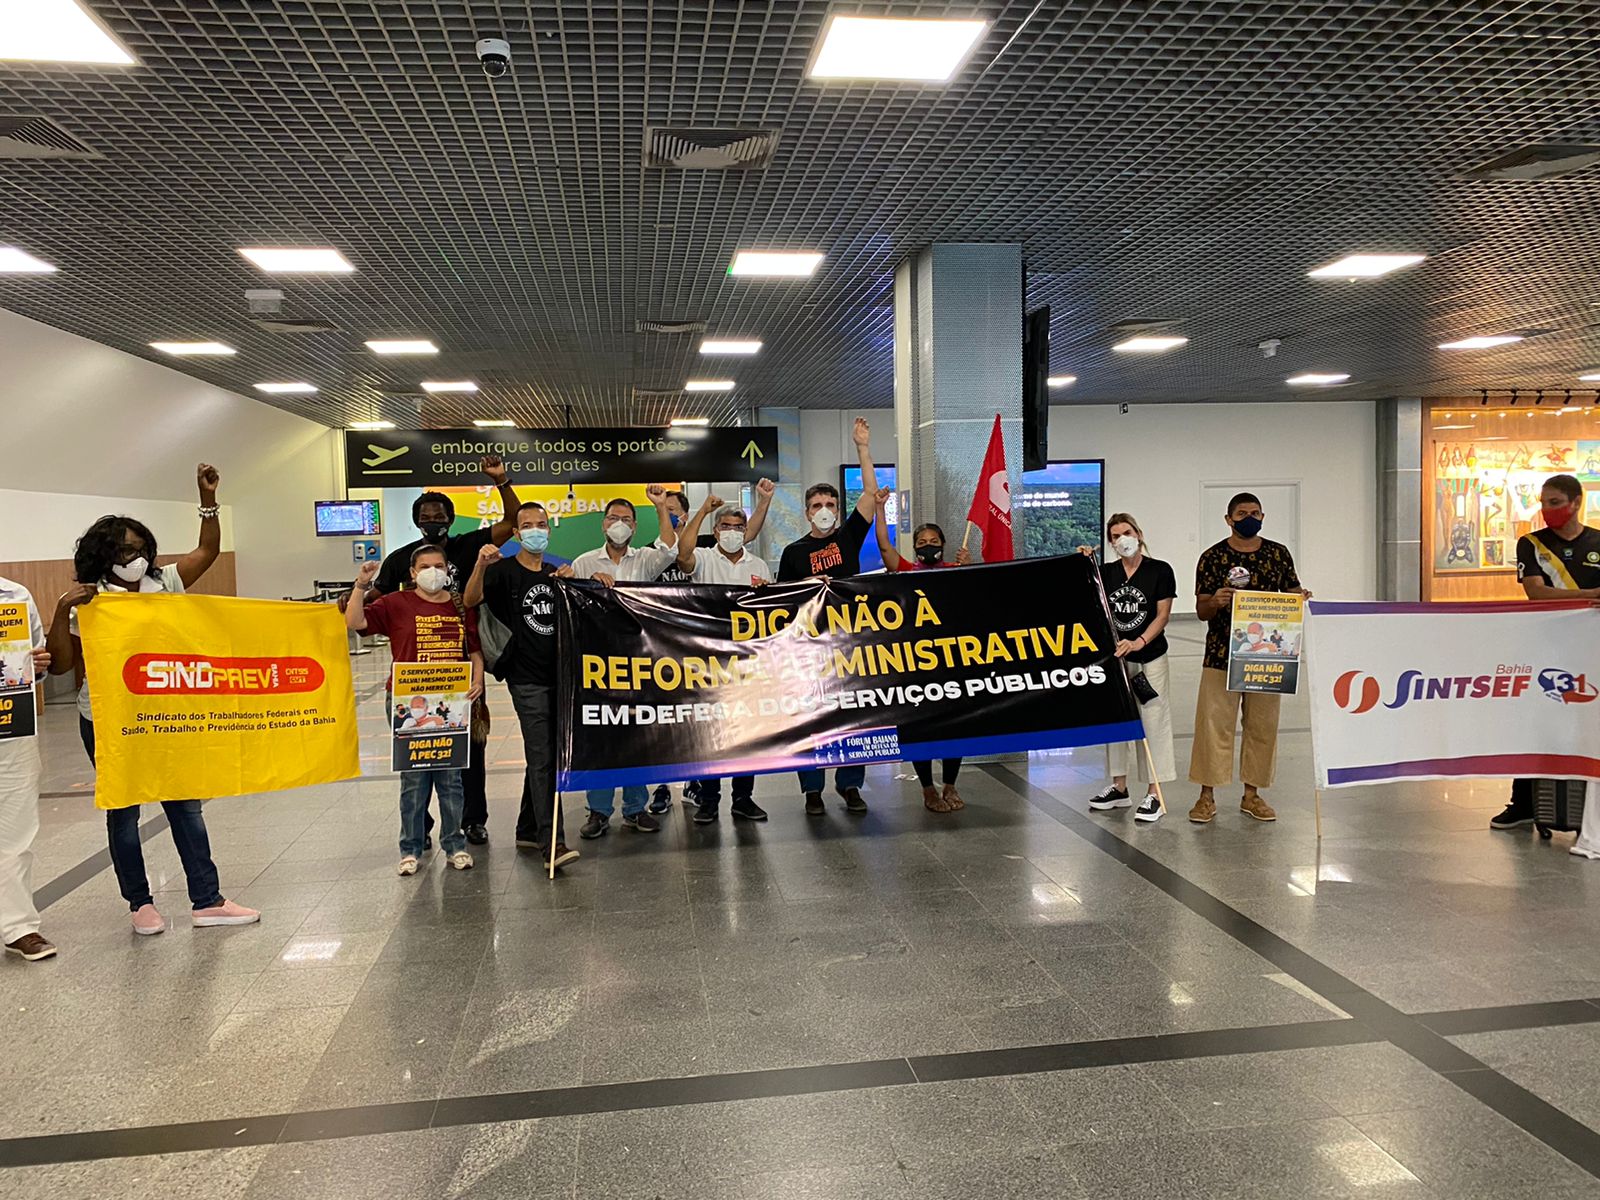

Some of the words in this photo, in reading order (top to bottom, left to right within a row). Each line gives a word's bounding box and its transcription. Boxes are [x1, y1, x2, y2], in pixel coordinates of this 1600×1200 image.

[431, 439, 529, 457] embarque
[535, 439, 586, 454] todos
[591, 441, 612, 453] os
[617, 438, 688, 456] portões
[525, 458, 545, 472] all
[550, 458, 600, 476] gates
[823, 554, 842, 570] LUTA
[825, 593, 904, 636] NÃO
[914, 589, 942, 628] À
[1114, 600, 1138, 614] NÃO!
[1244, 664, 1264, 672] DIGA
[1266, 664, 1284, 673] NÃO
[1496, 664, 1532, 675] Bahia
[1252, 674, 1268, 682] PEC
[1268, 674, 1282, 684] 32!
[582, 704, 630, 726] EM
[636, 698, 754, 726] DEFESA
[821, 681, 962, 711] SERVIÇOS
[966, 665, 1107, 698] PÚBLICOS
[1383, 670, 1531, 710] SINTSEF
[136, 712, 186, 722] Sindicato
[189, 712, 206, 720] dos
[209, 712, 264, 720] Trabalhadores
[266, 710, 301, 718] Federais
[152, 724, 197, 733] Trabalho
[208, 722, 255, 732] Previdência
[256, 722, 266, 730] do
[269, 720, 298, 730] Estado
[313, 716, 336, 726] Bahia
[409, 740, 432, 750] DIGA
[433, 736, 453, 748] NÃO
[846, 736, 871, 747] FÓRUM
[418, 750, 436, 760] PEC
[437, 749, 452, 760] 32!
[848, 750, 874, 759] SERVIÇO
[874, 748, 900, 756] PÚBLICO
